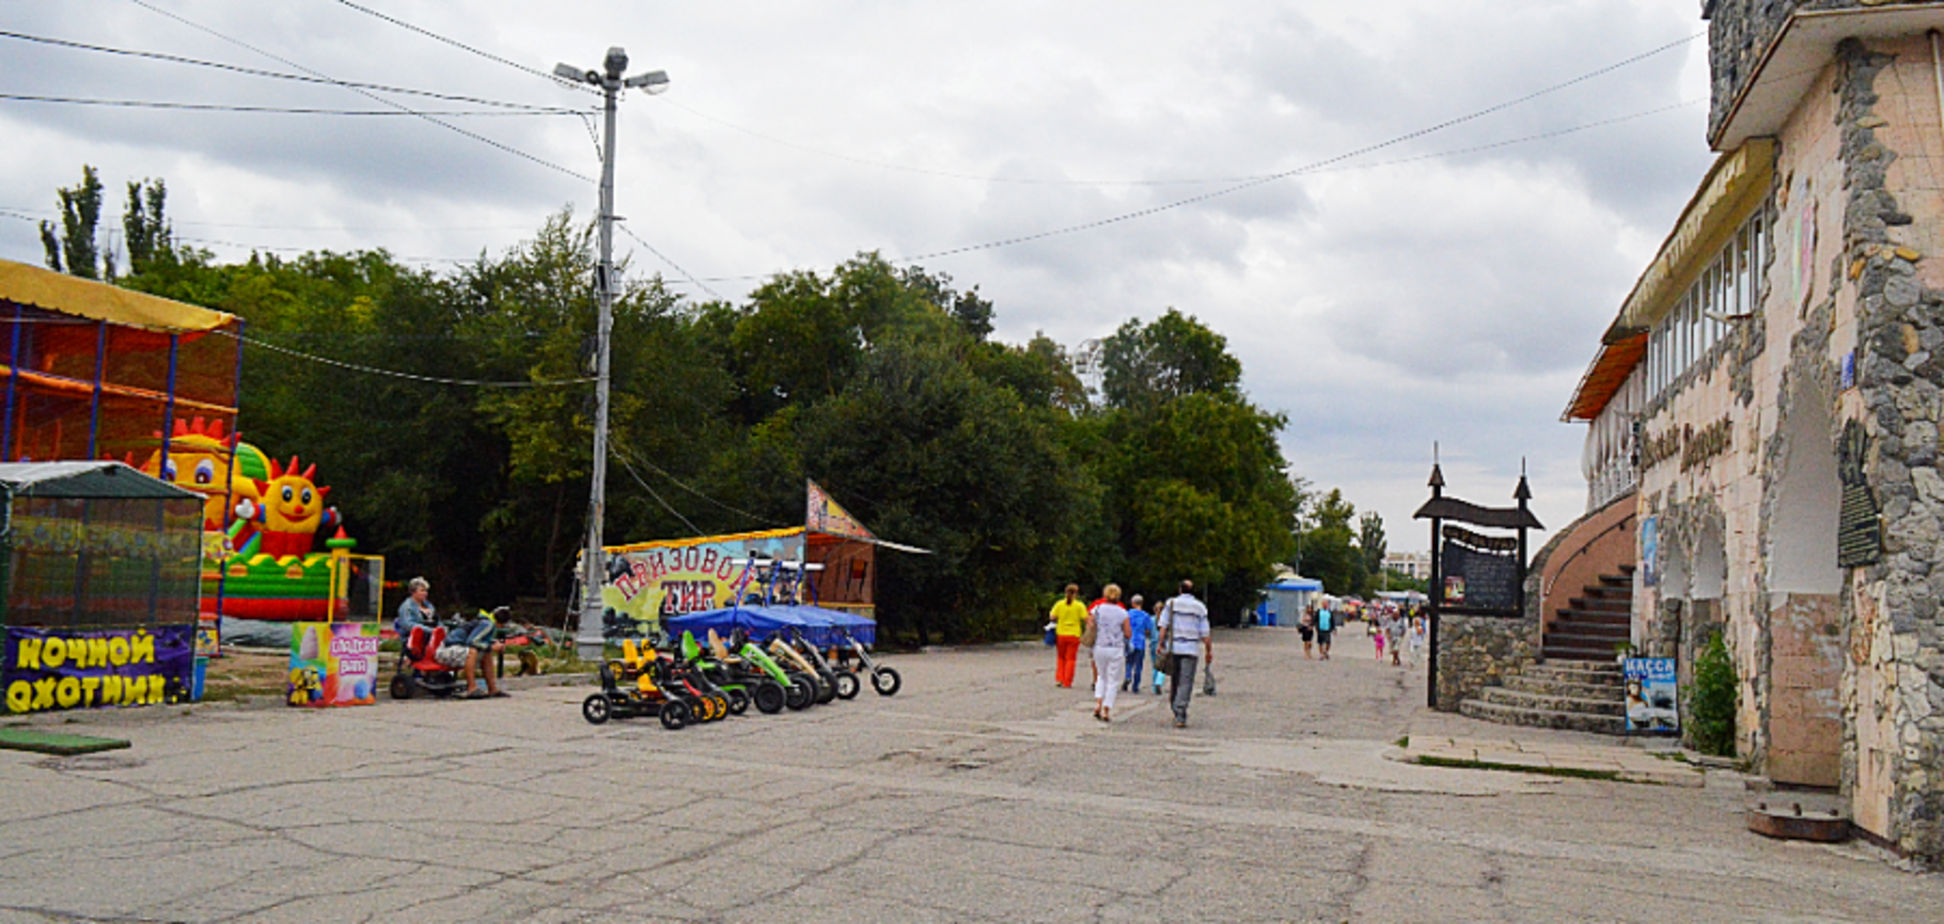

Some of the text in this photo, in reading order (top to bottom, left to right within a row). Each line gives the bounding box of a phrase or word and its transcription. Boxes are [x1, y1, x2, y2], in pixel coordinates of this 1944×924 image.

[660, 580, 716, 613] ТИР
[17, 628, 155, 669] НОЧНОЙ
[1626, 660, 1673, 672] КАССА
[7, 673, 166, 713] ОХОТНИК
